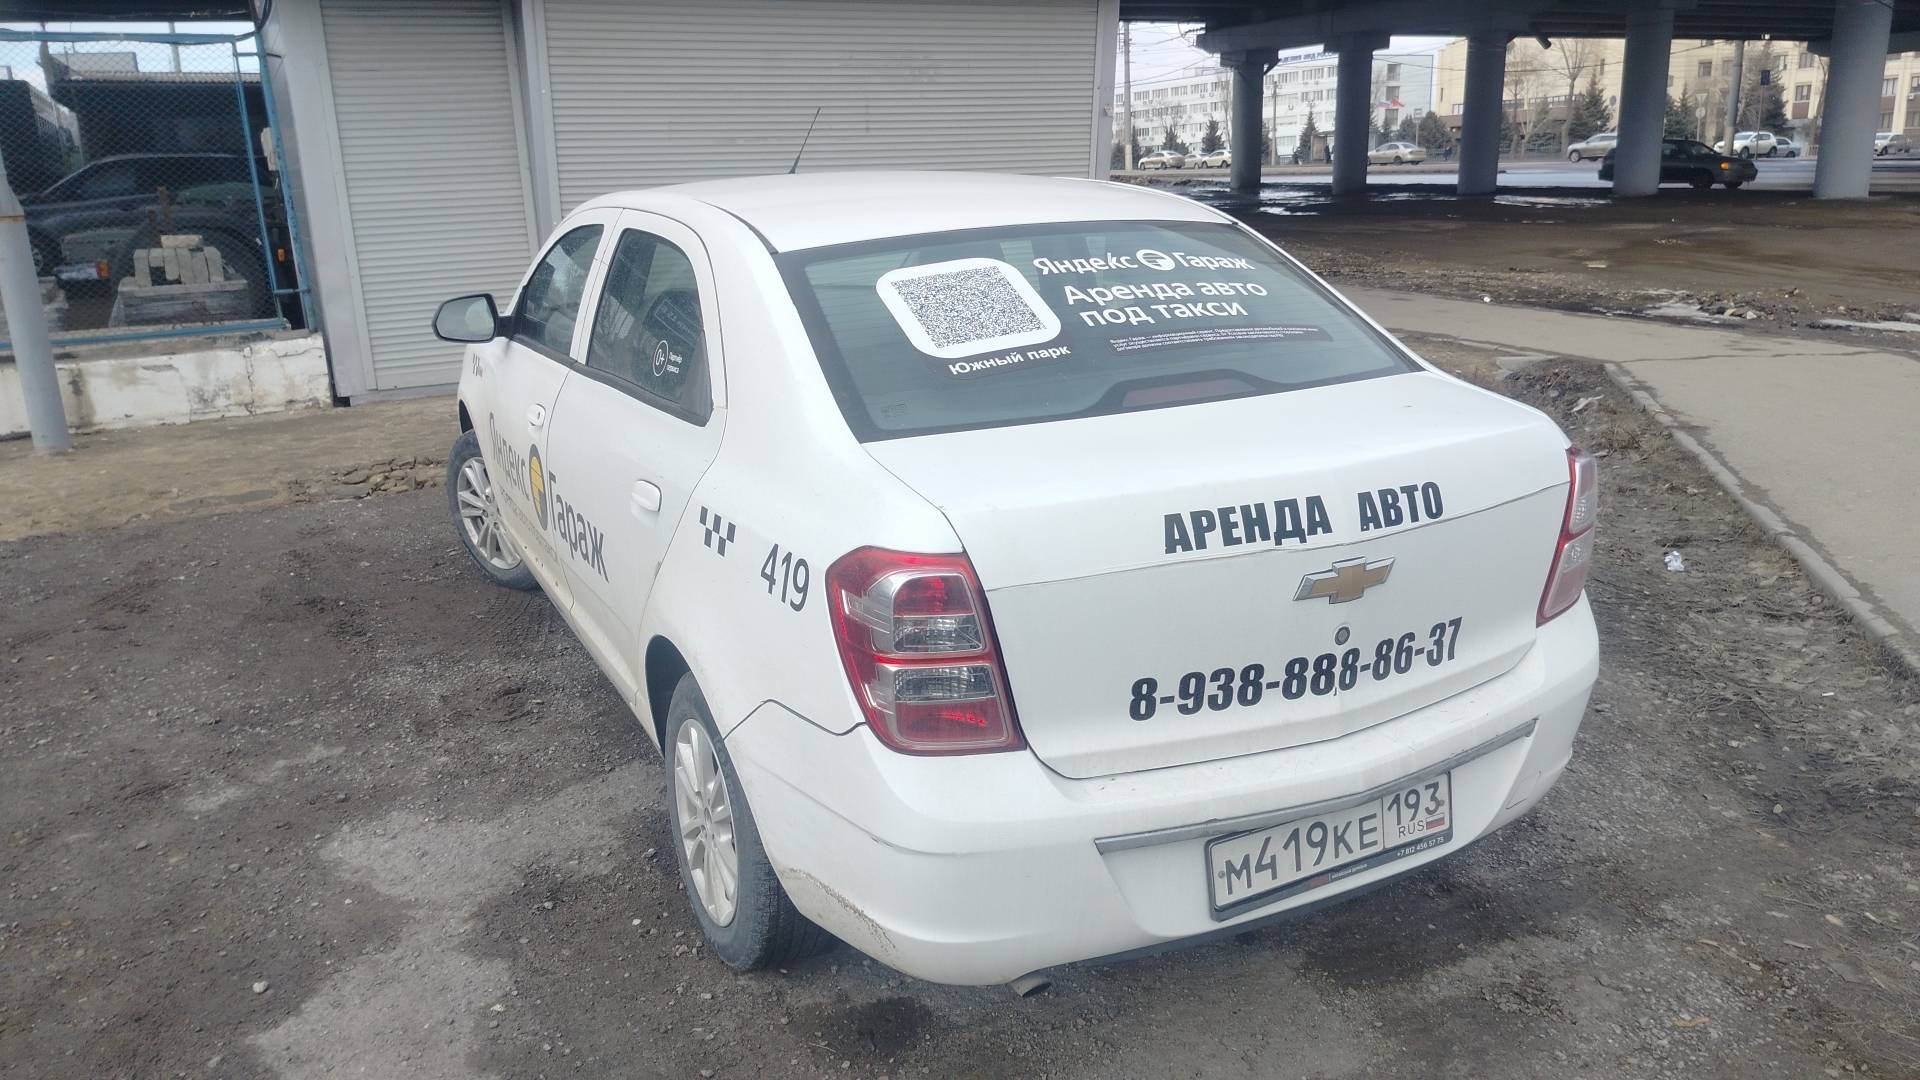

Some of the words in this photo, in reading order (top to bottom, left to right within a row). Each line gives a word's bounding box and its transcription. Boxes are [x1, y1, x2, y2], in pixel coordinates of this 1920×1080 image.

[1033, 252, 1138, 275] Яндекс
[1171, 252, 1255, 270] Гараж
[1063, 282, 1195, 306] Аренда
[1196, 281, 1268, 297] авто
[1079, 306, 1155, 327] под
[1150, 301, 1249, 320] такси
[948, 351, 1025, 375] Южный
[1026, 345, 1072, 359] парк
[489, 411, 530, 501] Яндекс
[548, 470, 610, 583] Гараж
[1164, 495, 1333, 555] АРЕНДА
[1357, 481, 1444, 532] АВТО
[760, 543, 810, 613] 419
[1128, 616, 1463, 722] 8-938-888-86-37
[1387, 781, 1441, 827] 193
[1398, 820, 1425, 839] RUS
